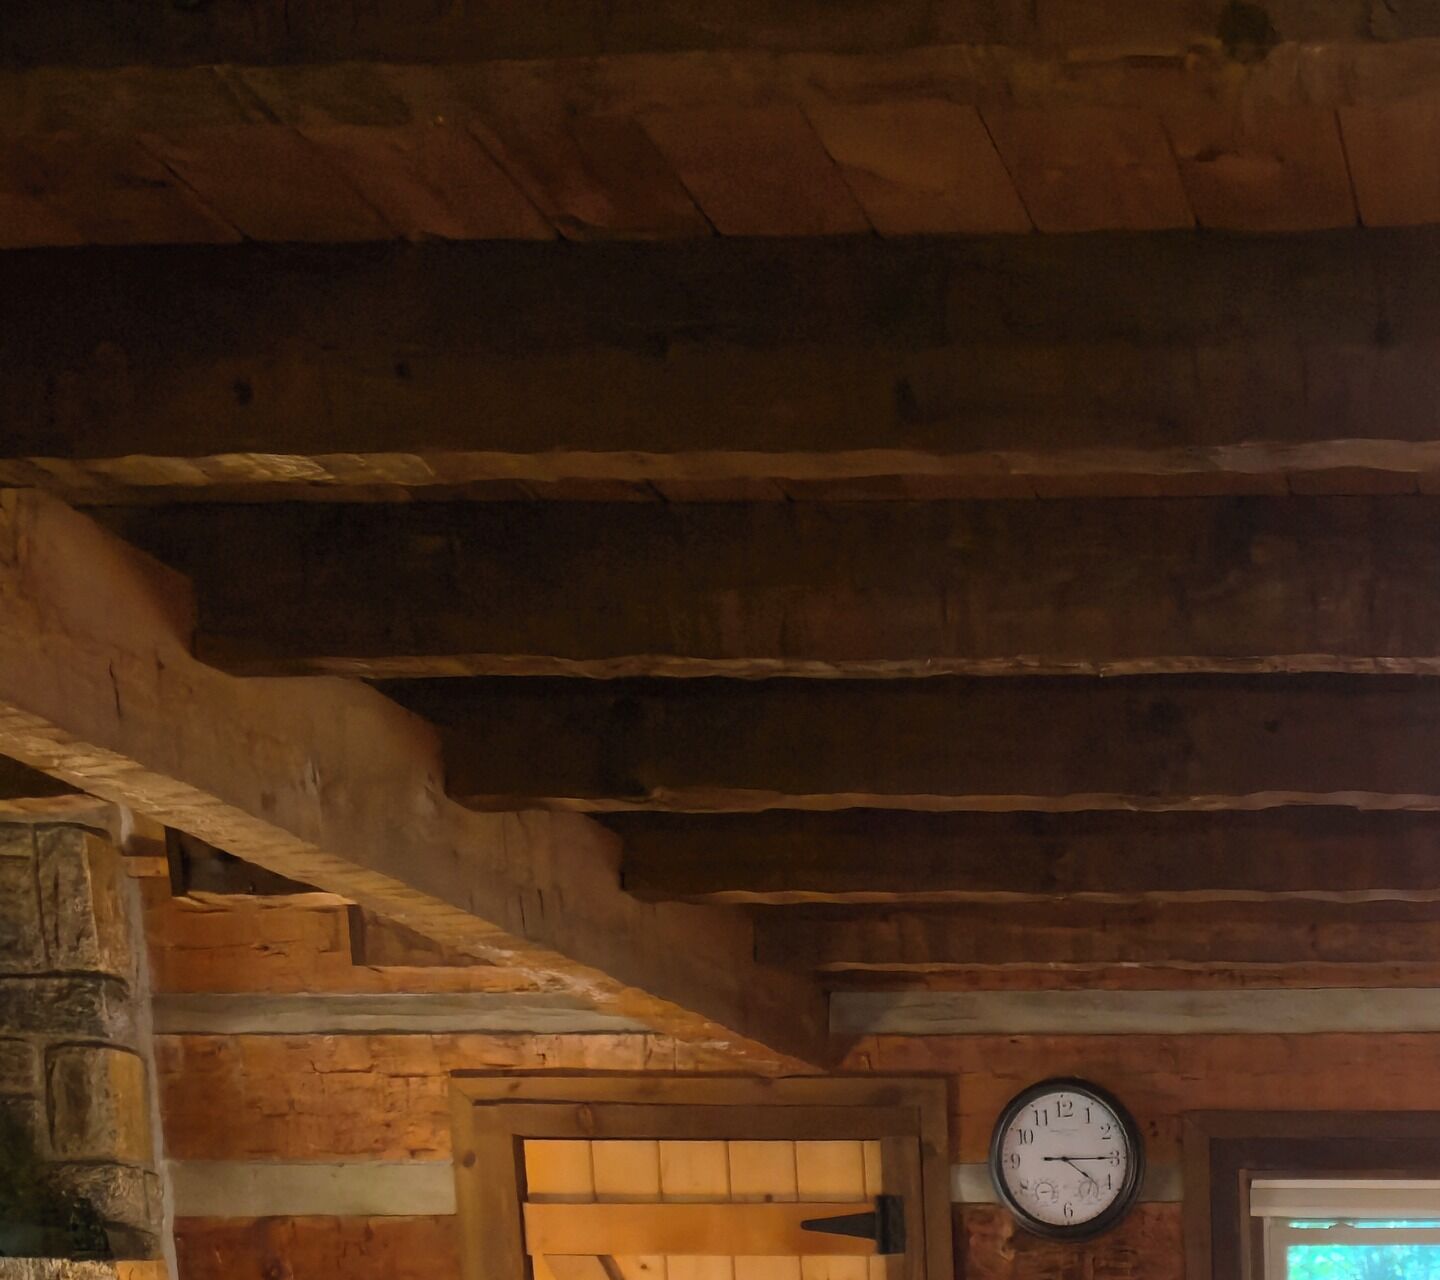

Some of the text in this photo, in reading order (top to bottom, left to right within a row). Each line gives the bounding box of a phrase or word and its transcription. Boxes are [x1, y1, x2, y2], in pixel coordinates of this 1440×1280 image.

[1056, 1101, 1074, 1118] 12
[1034, 1110, 1047, 1126] 11
[1018, 1129, 1034, 1145] 10
[1100, 1122, 1111, 1140] 2
[1011, 1153, 1020, 1168] 9
[1109, 1150, 1120, 1167] 3
[1064, 1202, 1074, 1218] 6
